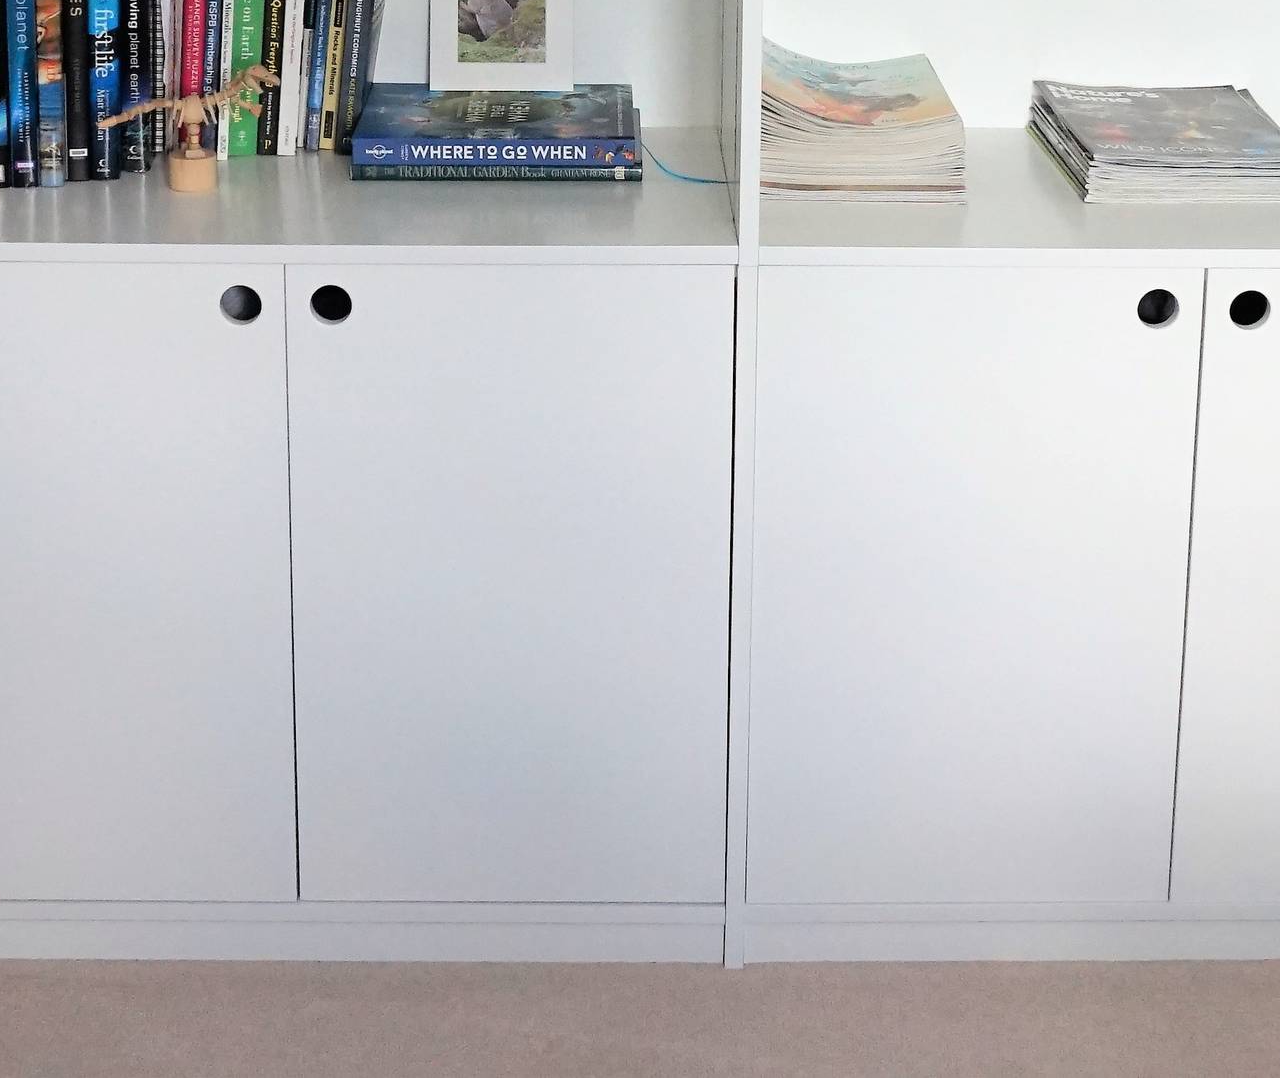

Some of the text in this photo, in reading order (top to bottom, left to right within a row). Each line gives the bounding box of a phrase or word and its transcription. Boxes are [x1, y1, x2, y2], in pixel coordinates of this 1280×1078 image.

[207, 0, 218, 27] RSPB
[242, 6, 252, 23] on
[94, 7, 115, 78] first life
[127, 32, 141, 69] planet
[191, 27, 201, 58] SURVEY
[239, 25, 255, 61] Earth
[265, 0, 282, 88] Question Everythg
[332, 30, 341, 51] Rocks
[204, 28, 217, 85] membership
[331, 53, 339, 66] and
[349, 33, 361, 78] ECONOMICS
[190, 59, 199, 88] PUZZLE
[328, 67, 338, 95] Minerals
[348, 77, 358, 95] KATE
[128, 73, 141, 103] earth
[1044, 84, 1160, 99] Nature's
[1052, 91, 1133, 103] Home
[96, 112, 106, 141] Kalan
[411, 145, 587, 160] WHERE TO GO WHEN
[398, 166, 471, 178] TRADITIONAL
[472, 166, 519, 178] GARDEN
[521, 167, 546, 178] Book
